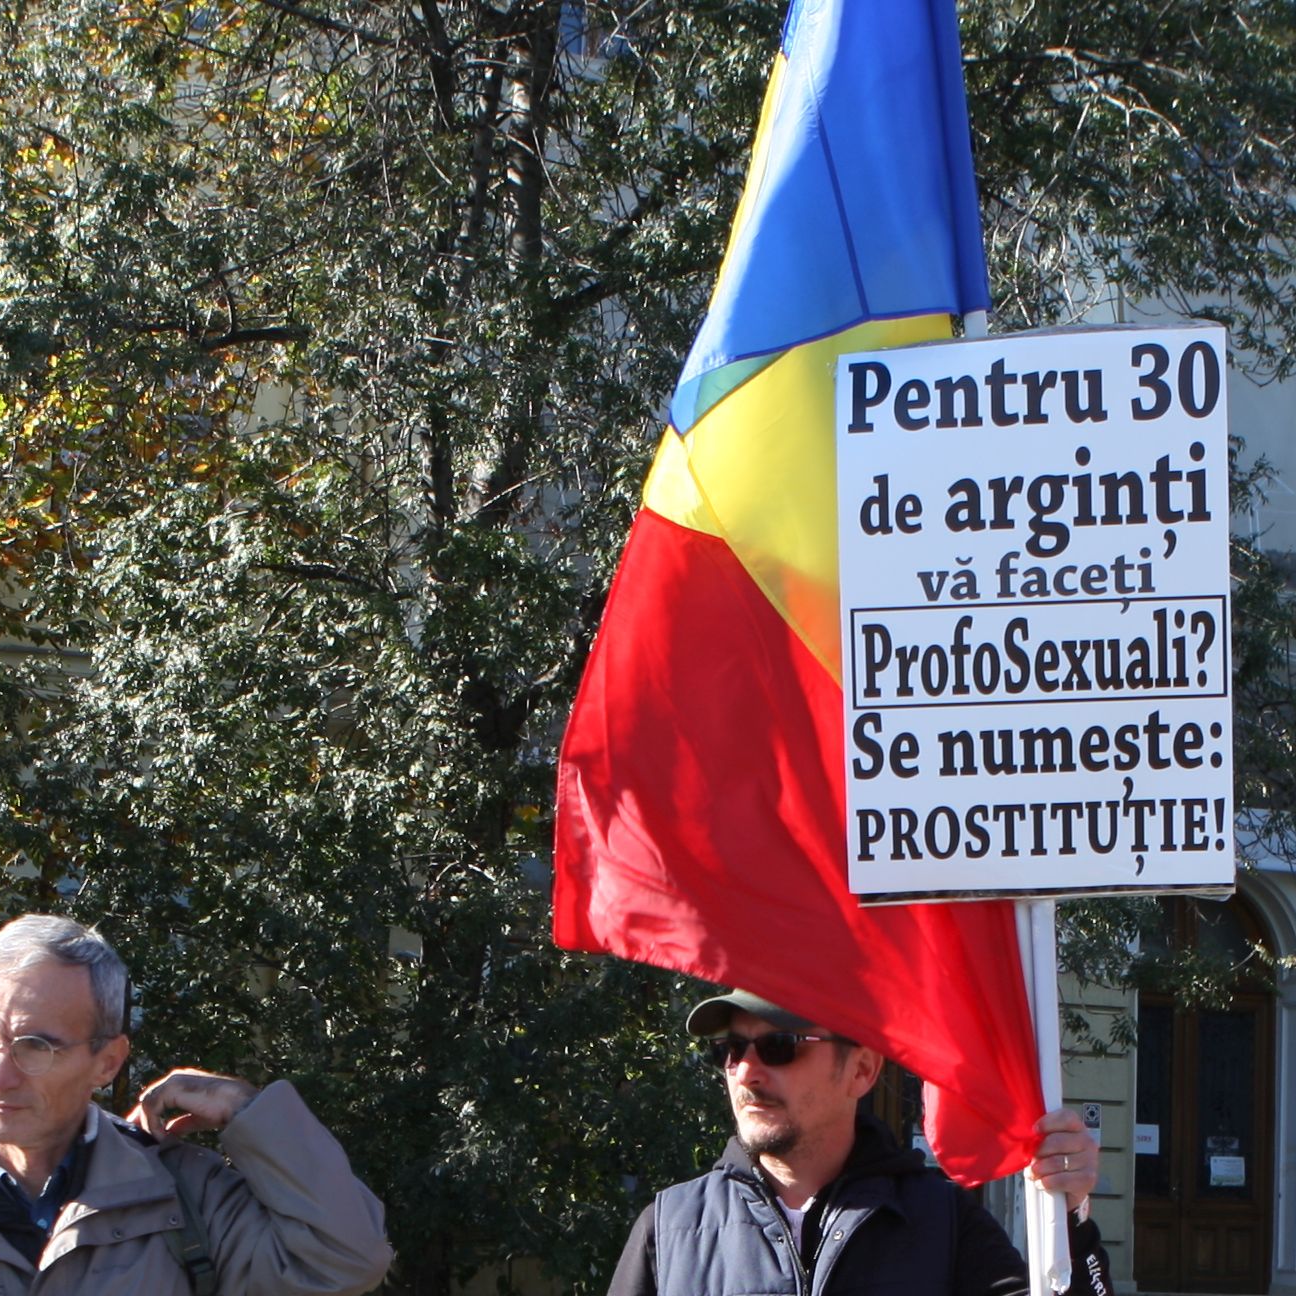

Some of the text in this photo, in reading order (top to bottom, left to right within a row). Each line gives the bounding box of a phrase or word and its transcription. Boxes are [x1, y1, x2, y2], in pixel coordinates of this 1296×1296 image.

[848, 341, 1221, 433] Pentru 30
[860, 441, 1212, 560] de arginți
[918, 547, 1156, 614] vă faceți
[862, 607, 1216, 698] ProfoSexuali?
[853, 710, 1223, 801] Se numește:
[857, 797, 1225, 876] PROSTITUȚIE!
